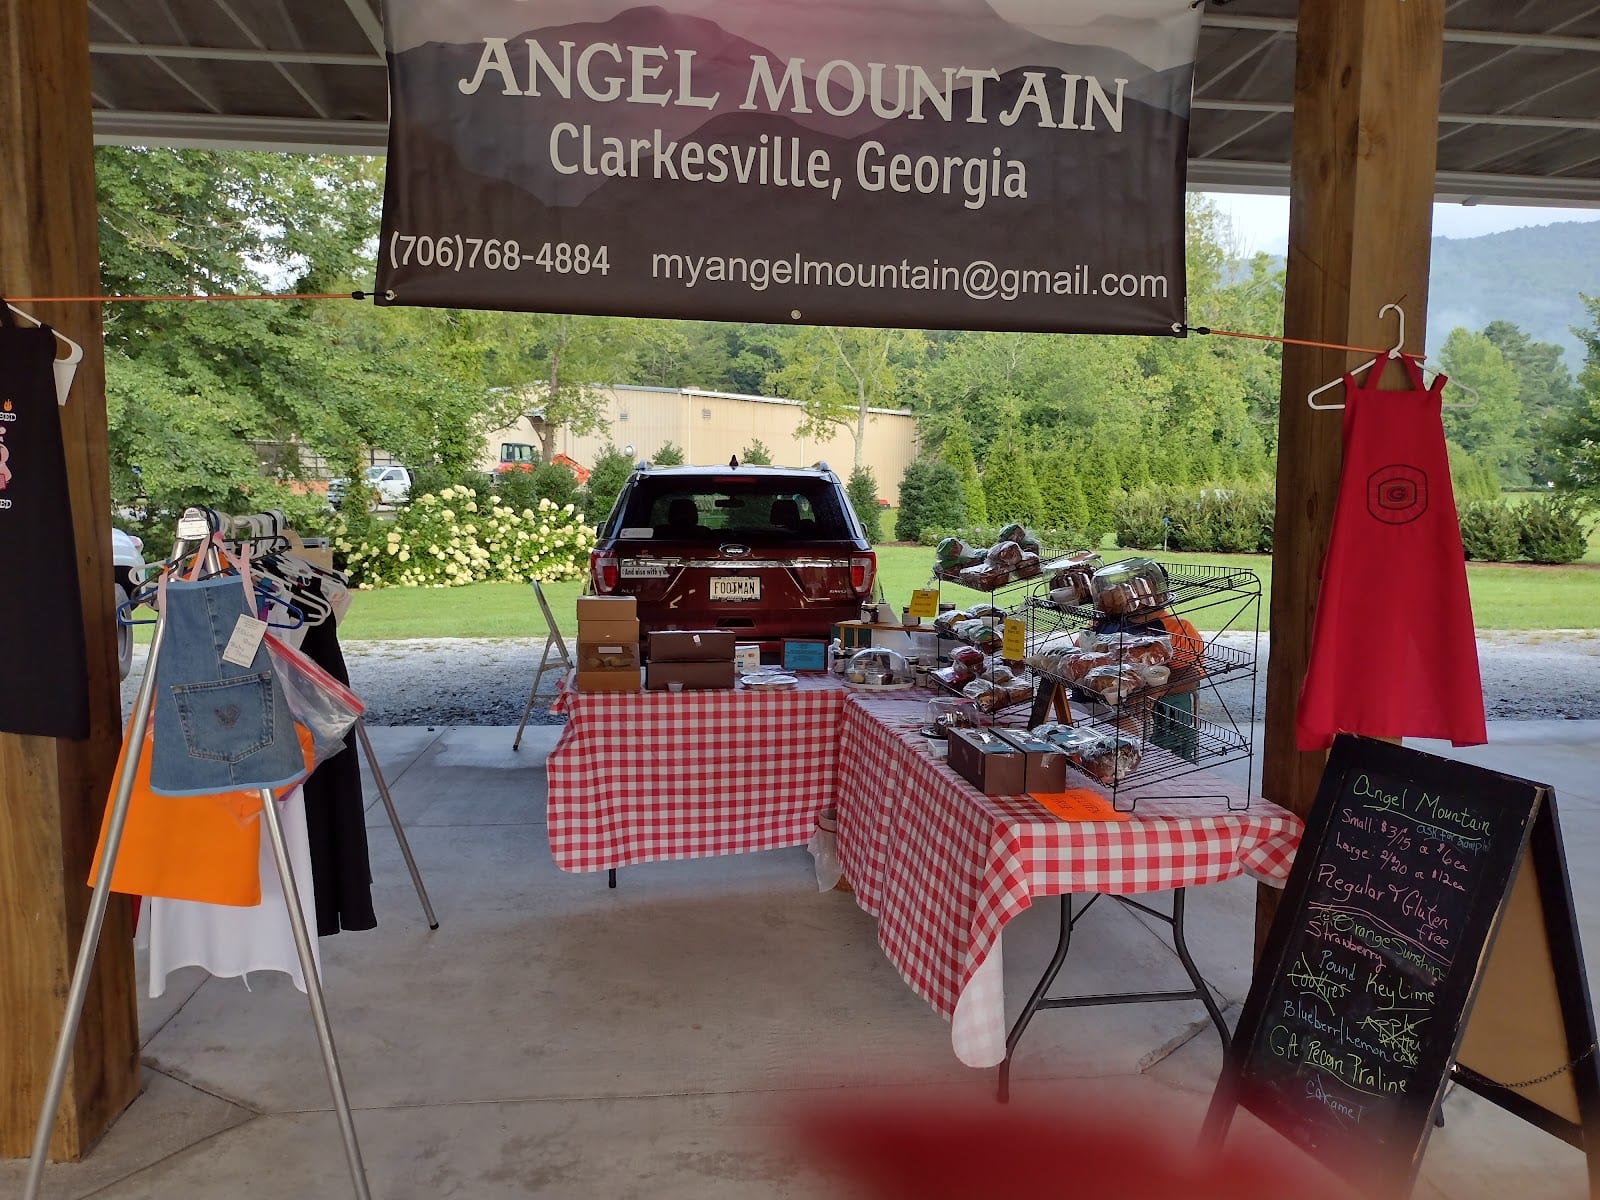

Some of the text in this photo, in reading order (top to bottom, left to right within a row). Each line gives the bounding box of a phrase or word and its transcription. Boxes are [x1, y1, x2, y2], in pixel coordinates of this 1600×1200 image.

[458, 37, 1128, 133] ANGEL MOUNTAIN
[549, 122, 1028, 210] Clarkesville, Georgia
[390, 230, 1168, 300] (706)768-4884 myangelmountain@gmail.com
[714, 581, 755, 595] FOOTMAN
[1353, 774, 1491, 837] Angel Mountain
[1317, 864, 1386, 902] Regular
[1401, 889, 1449, 930] Gluten
[1304, 920, 1387, 974] Strawberry
[1318, 949, 1356, 981] Pound
[1269, 1025, 1407, 1094] GA Pecan Praline
